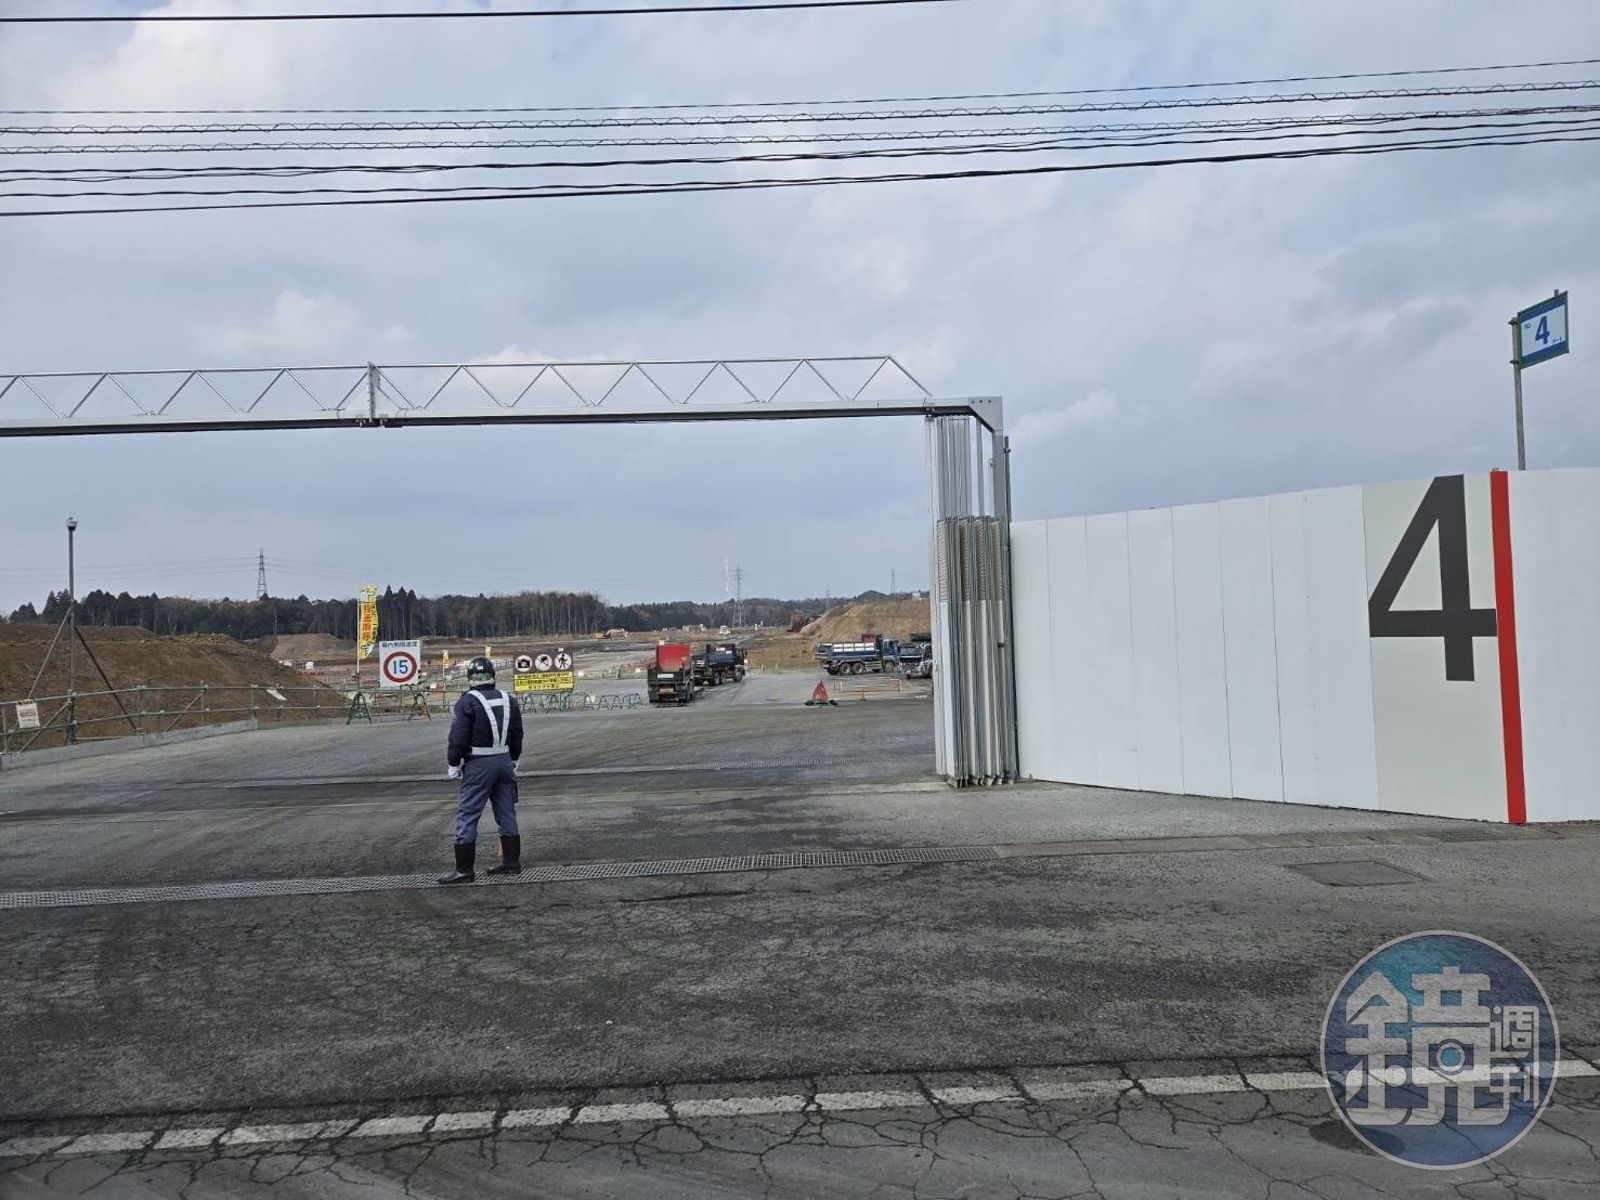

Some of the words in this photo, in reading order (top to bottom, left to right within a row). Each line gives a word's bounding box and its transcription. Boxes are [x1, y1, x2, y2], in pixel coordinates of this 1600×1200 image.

[1535, 315, 1550, 345] 4
[1368, 474, 1497, 681] 4
[393, 660, 409, 674] 15
